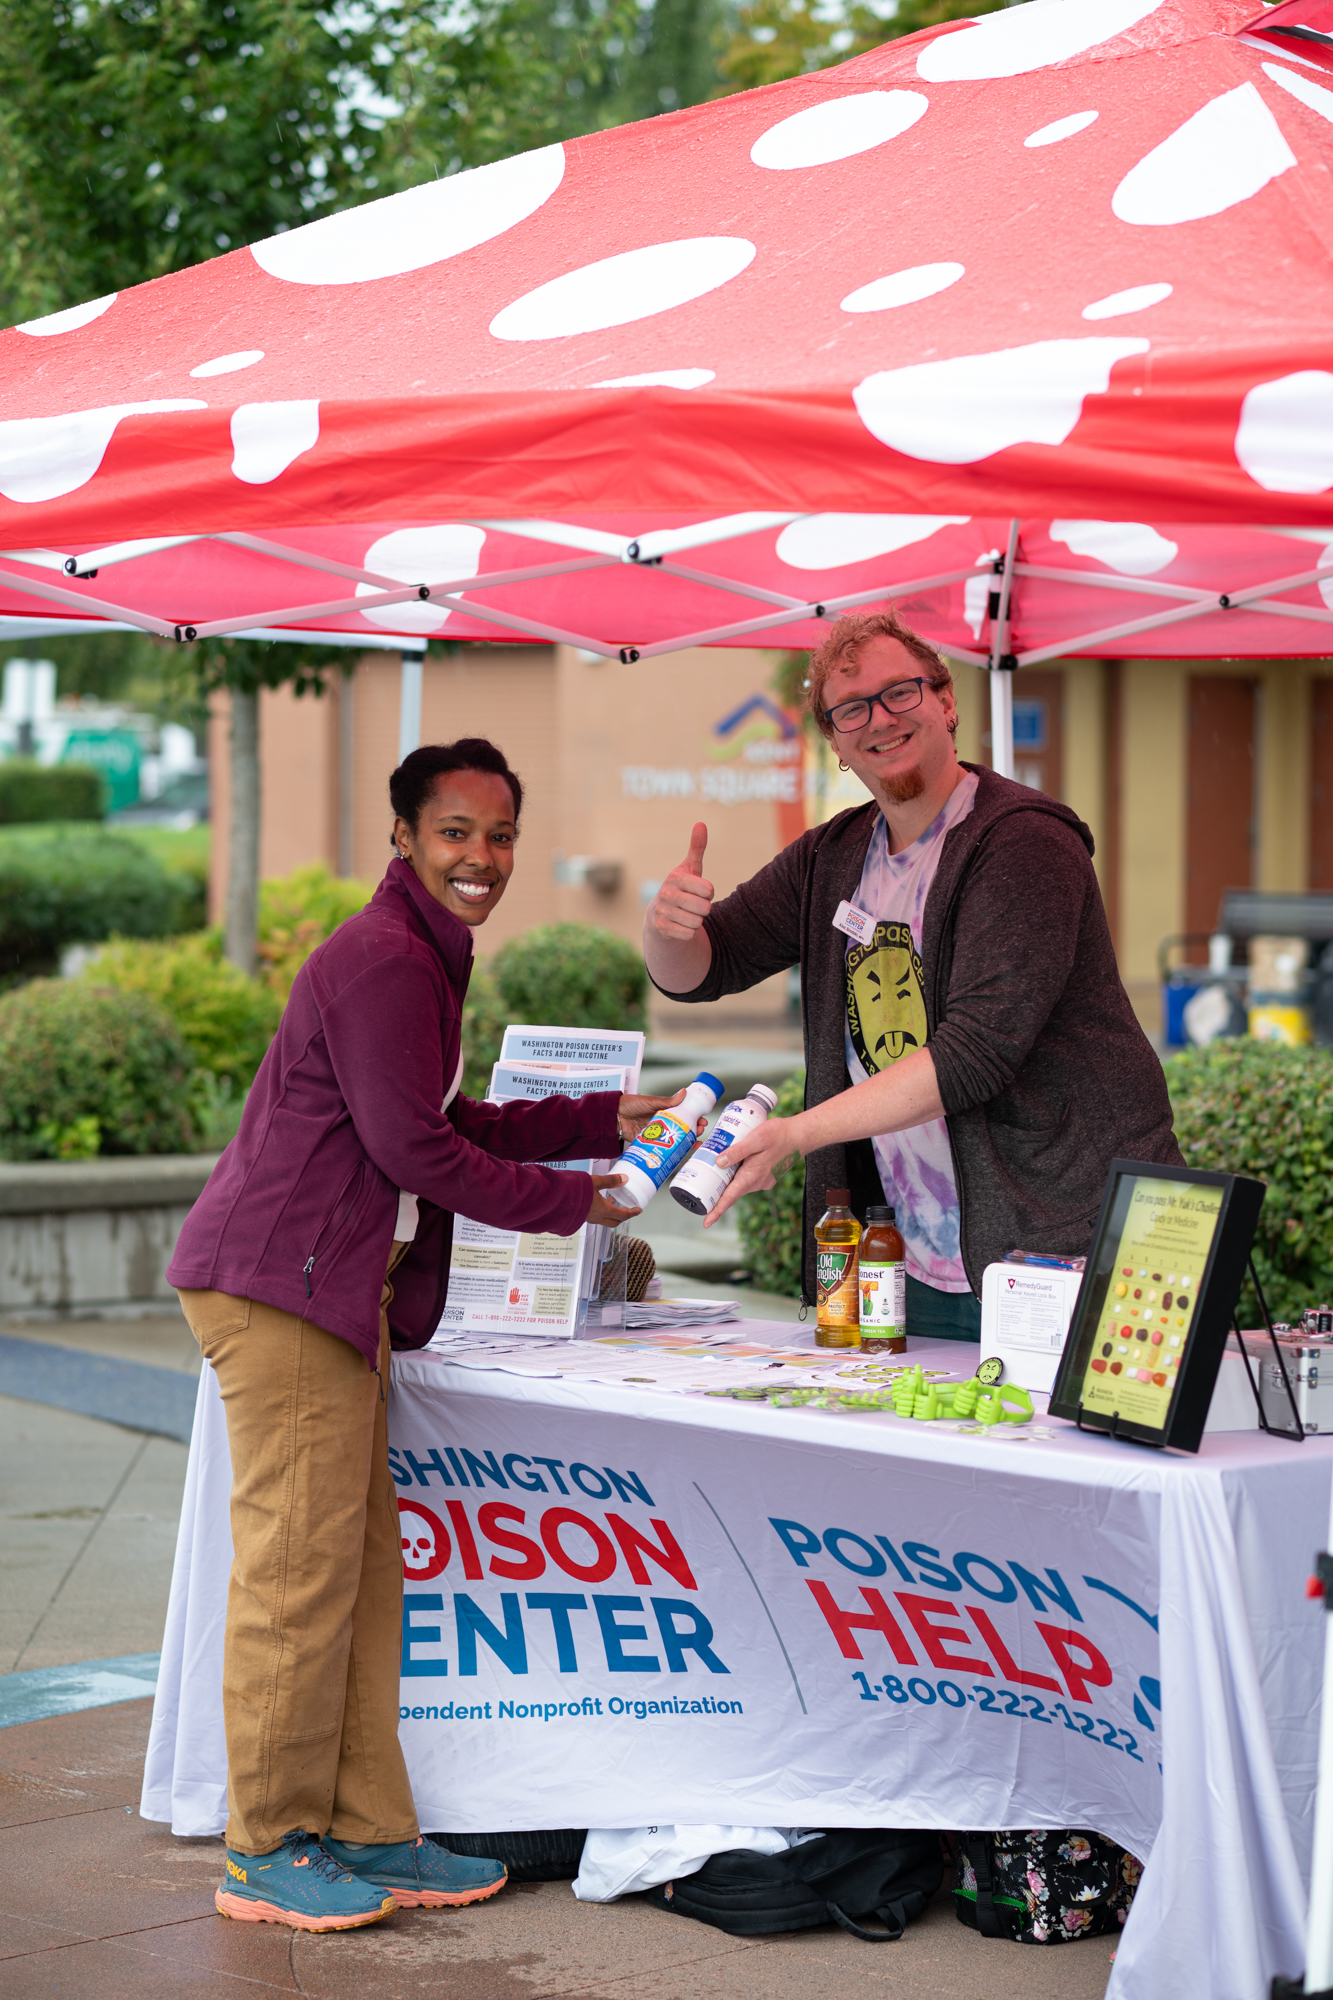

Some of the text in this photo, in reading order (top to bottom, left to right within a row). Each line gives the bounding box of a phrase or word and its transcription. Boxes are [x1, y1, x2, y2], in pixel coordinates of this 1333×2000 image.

[845, 917, 864, 931] CENTER
[847, 912, 866, 926] POISON
[522, 1040, 622, 1052] WASHINGTON POISON CENTER'S
[533, 1049, 608, 1060] FACTS ABOUT NICOTINE
[512, 1076, 557, 1088] WASHINGTON
[583, 1080, 609, 1088] CENTER'S
[526, 1086, 548, 1096] FACTS
[1135, 1191, 1144, 1202] Can
[1144, 1195, 1153, 1206] you
[1154, 1196, 1167, 1206] pass
[1168, 1196, 1178, 1207] Mr.
[1179, 1198, 1195, 1211] Yuk's
[1150, 1211, 1166, 1225] Candy
[1174, 1215, 1199, 1229] Medicine
[820, 1254, 832, 1268] Old
[859, 1270, 882, 1279] onest
[1016, 1281, 1052, 1291] RemedyGuard
[389, 1447, 656, 1507] SHINGTON
[397, 1497, 698, 1591] OISON
[767, 1517, 1084, 1622] POISON
[400, 1592, 731, 1677] ENTER
[805, 1579, 1113, 1704] HELP
[499, 1697, 602, 1722] Nonprofit
[608, 1696, 743, 1718] Organization
[852, 1671, 1144, 1763] 1-800-222-1222
